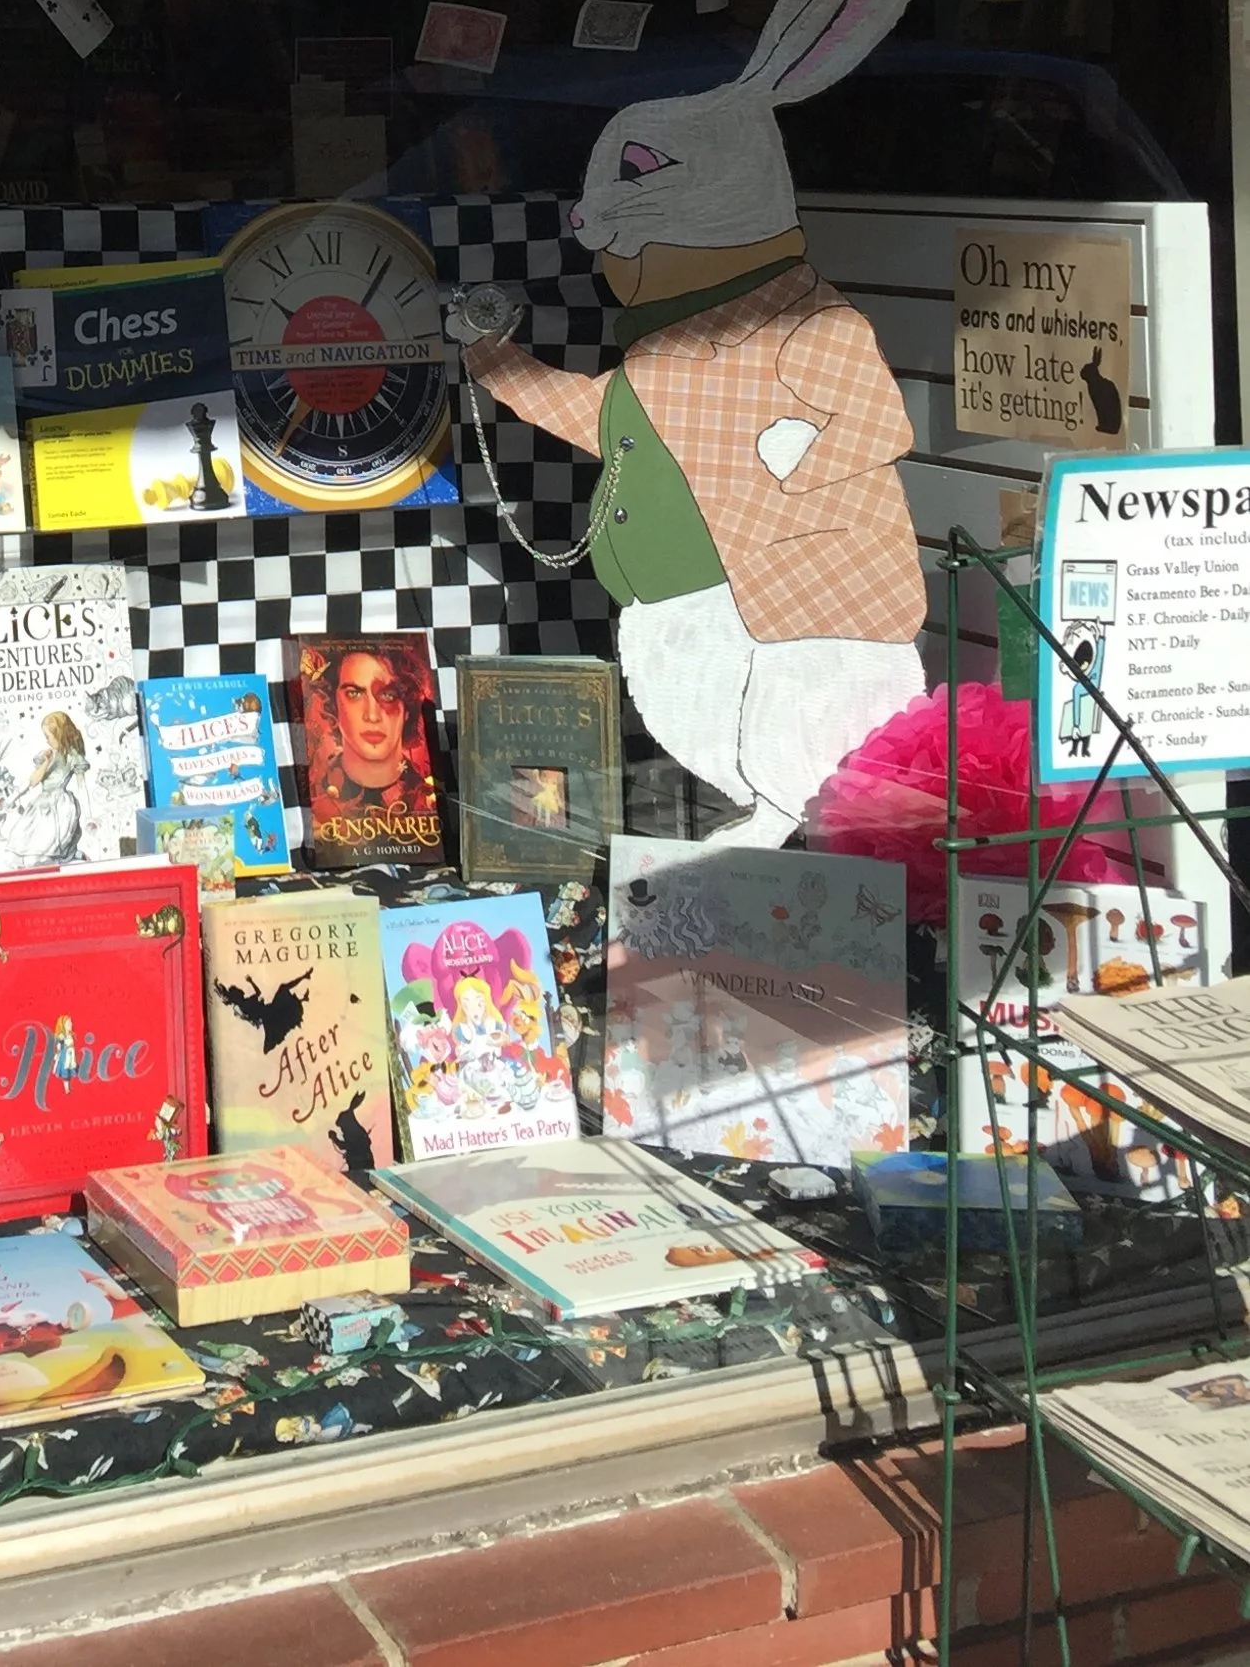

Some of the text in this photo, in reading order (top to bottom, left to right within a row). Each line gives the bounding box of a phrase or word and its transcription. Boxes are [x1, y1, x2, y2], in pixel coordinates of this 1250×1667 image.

[306, 230, 344, 267] XII
[959, 241, 1077, 303] Oh my
[73, 306, 178, 346] Chess
[960, 306, 1125, 347] ears and whiskers,
[235, 341, 431, 366] TIME and NAVIGATION
[960, 337, 1076, 385] how late
[64, 347, 195, 393] DUMMIES
[960, 377, 1086, 433] it's getting!
[337, 443, 348, 458] S
[1163, 532, 1195, 550] (tax
[1126, 559, 1240, 578] Grass Valley Union
[1068, 579, 1110, 608] NEWS
[1126, 585, 1221, 603] Sacramento Bee
[1127, 612, 1150, 627] S.F.
[1152, 610, 1210, 626] Chronicle
[1127, 636, 1201, 652] NYT Daily
[1127, 662, 1173, 676] Barrons
[47, 689, 79, 701] BOOK
[171, 679, 248, 692] LEWIS CARROLL
[1126, 682, 1218, 702] Sacramento Bee
[1150, 709, 1206, 725] Chronicle
[168, 714, 250, 748] ALICE'S
[1165, 731, 1208, 748] Sunday
[176, 749, 249, 772] ADVENTURES
[184, 783, 261, 802] WONDERLAND
[375, 844, 422, 857] HOWARD
[234, 922, 358, 947] GREGORY
[441, 933, 488, 955] ALICE
[235, 940, 360, 966] MAGUIRE
[442, 954, 494, 968] WONDERLAND
[677, 967, 826, 1004] WONDERLAND
[1118, 993, 1243, 1025] THE
[258, 1022, 340, 1099] After
[291, 1050, 374, 1125] Alice
[10, 1110, 146, 1137] LEWIS CARROLL
[423, 1118, 572, 1153] Mad Hatter's Tea Party
[489, 1198, 613, 1230] USE YOUR
[563, 1249, 632, 1268] NICOLA
